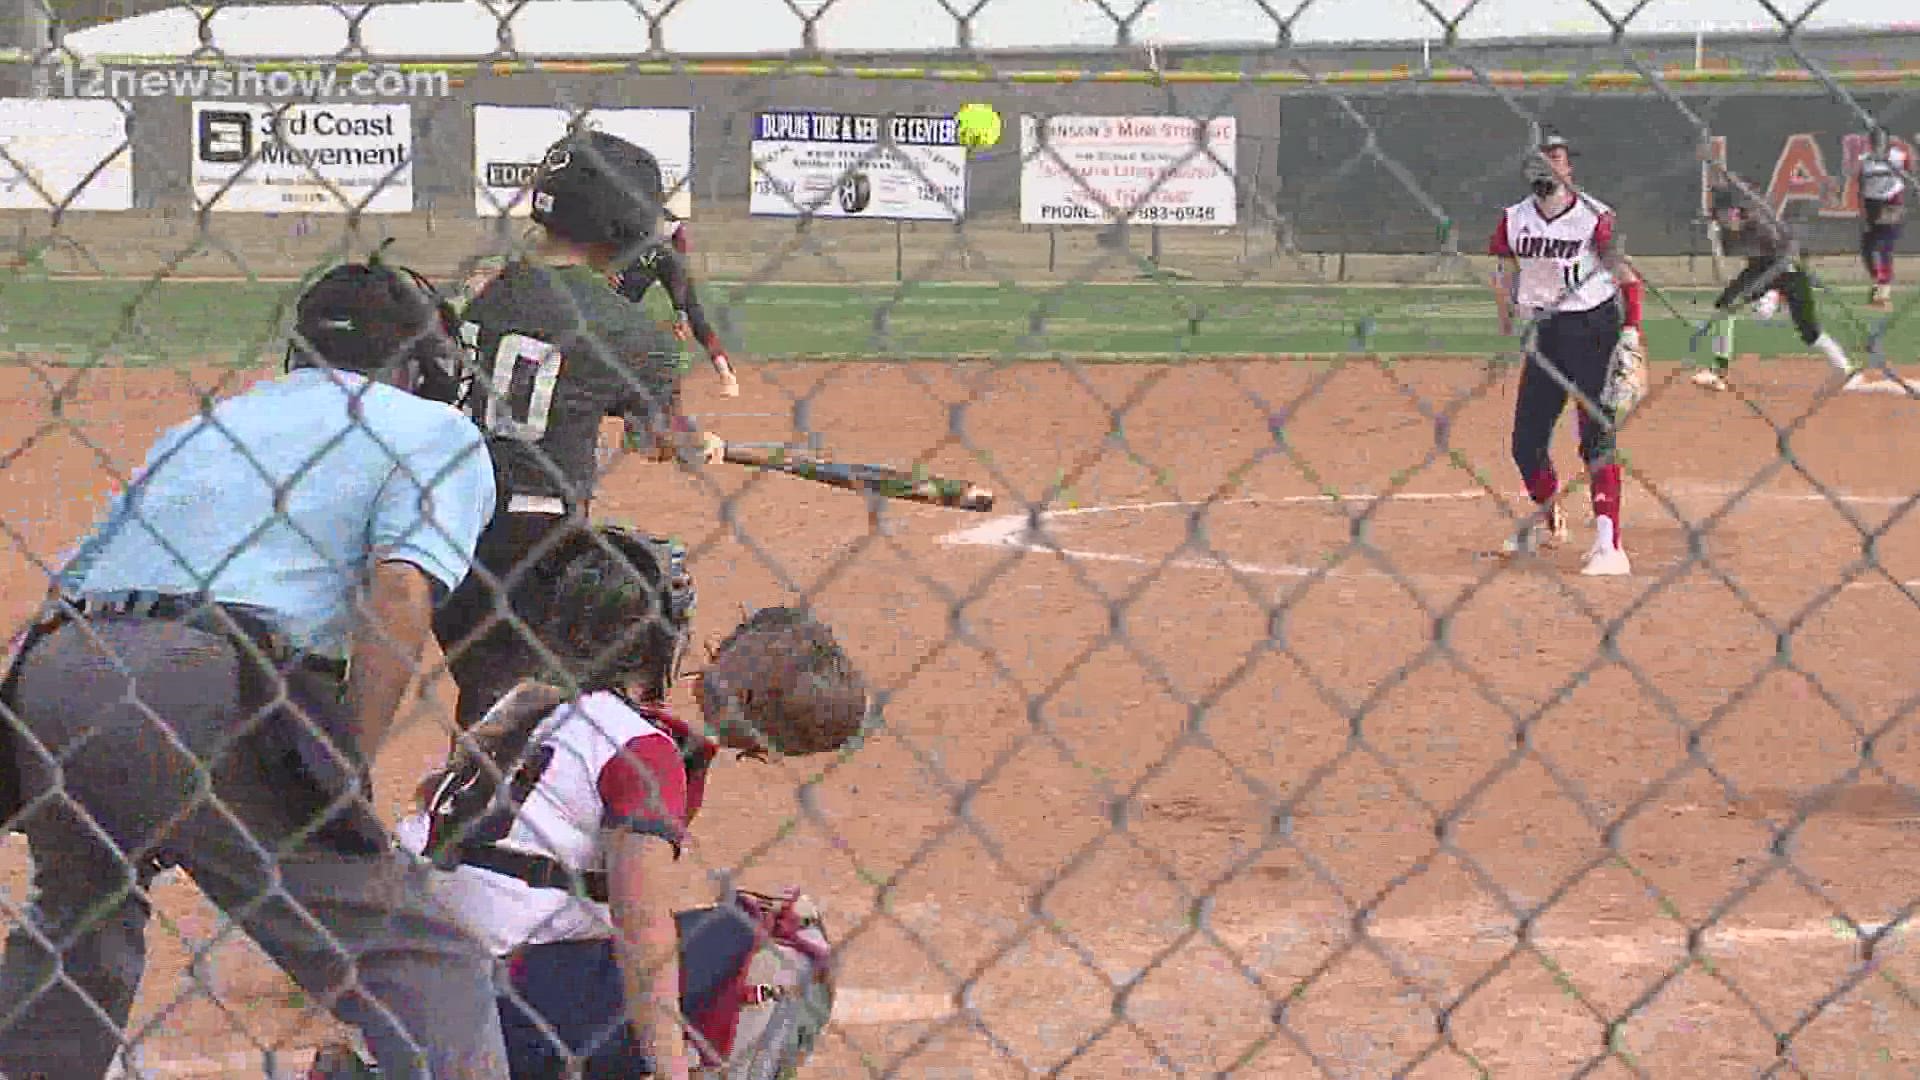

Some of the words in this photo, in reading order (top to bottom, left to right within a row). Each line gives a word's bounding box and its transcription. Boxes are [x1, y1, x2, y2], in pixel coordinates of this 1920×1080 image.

[260, 110, 307, 136] 3d
[312, 110, 395, 137] Coast
[813, 113, 841, 140] TIRE
[854, 115, 906, 142] SERCE
[907, 116, 957, 143] CENTER
[260, 140, 407, 166] Movement
